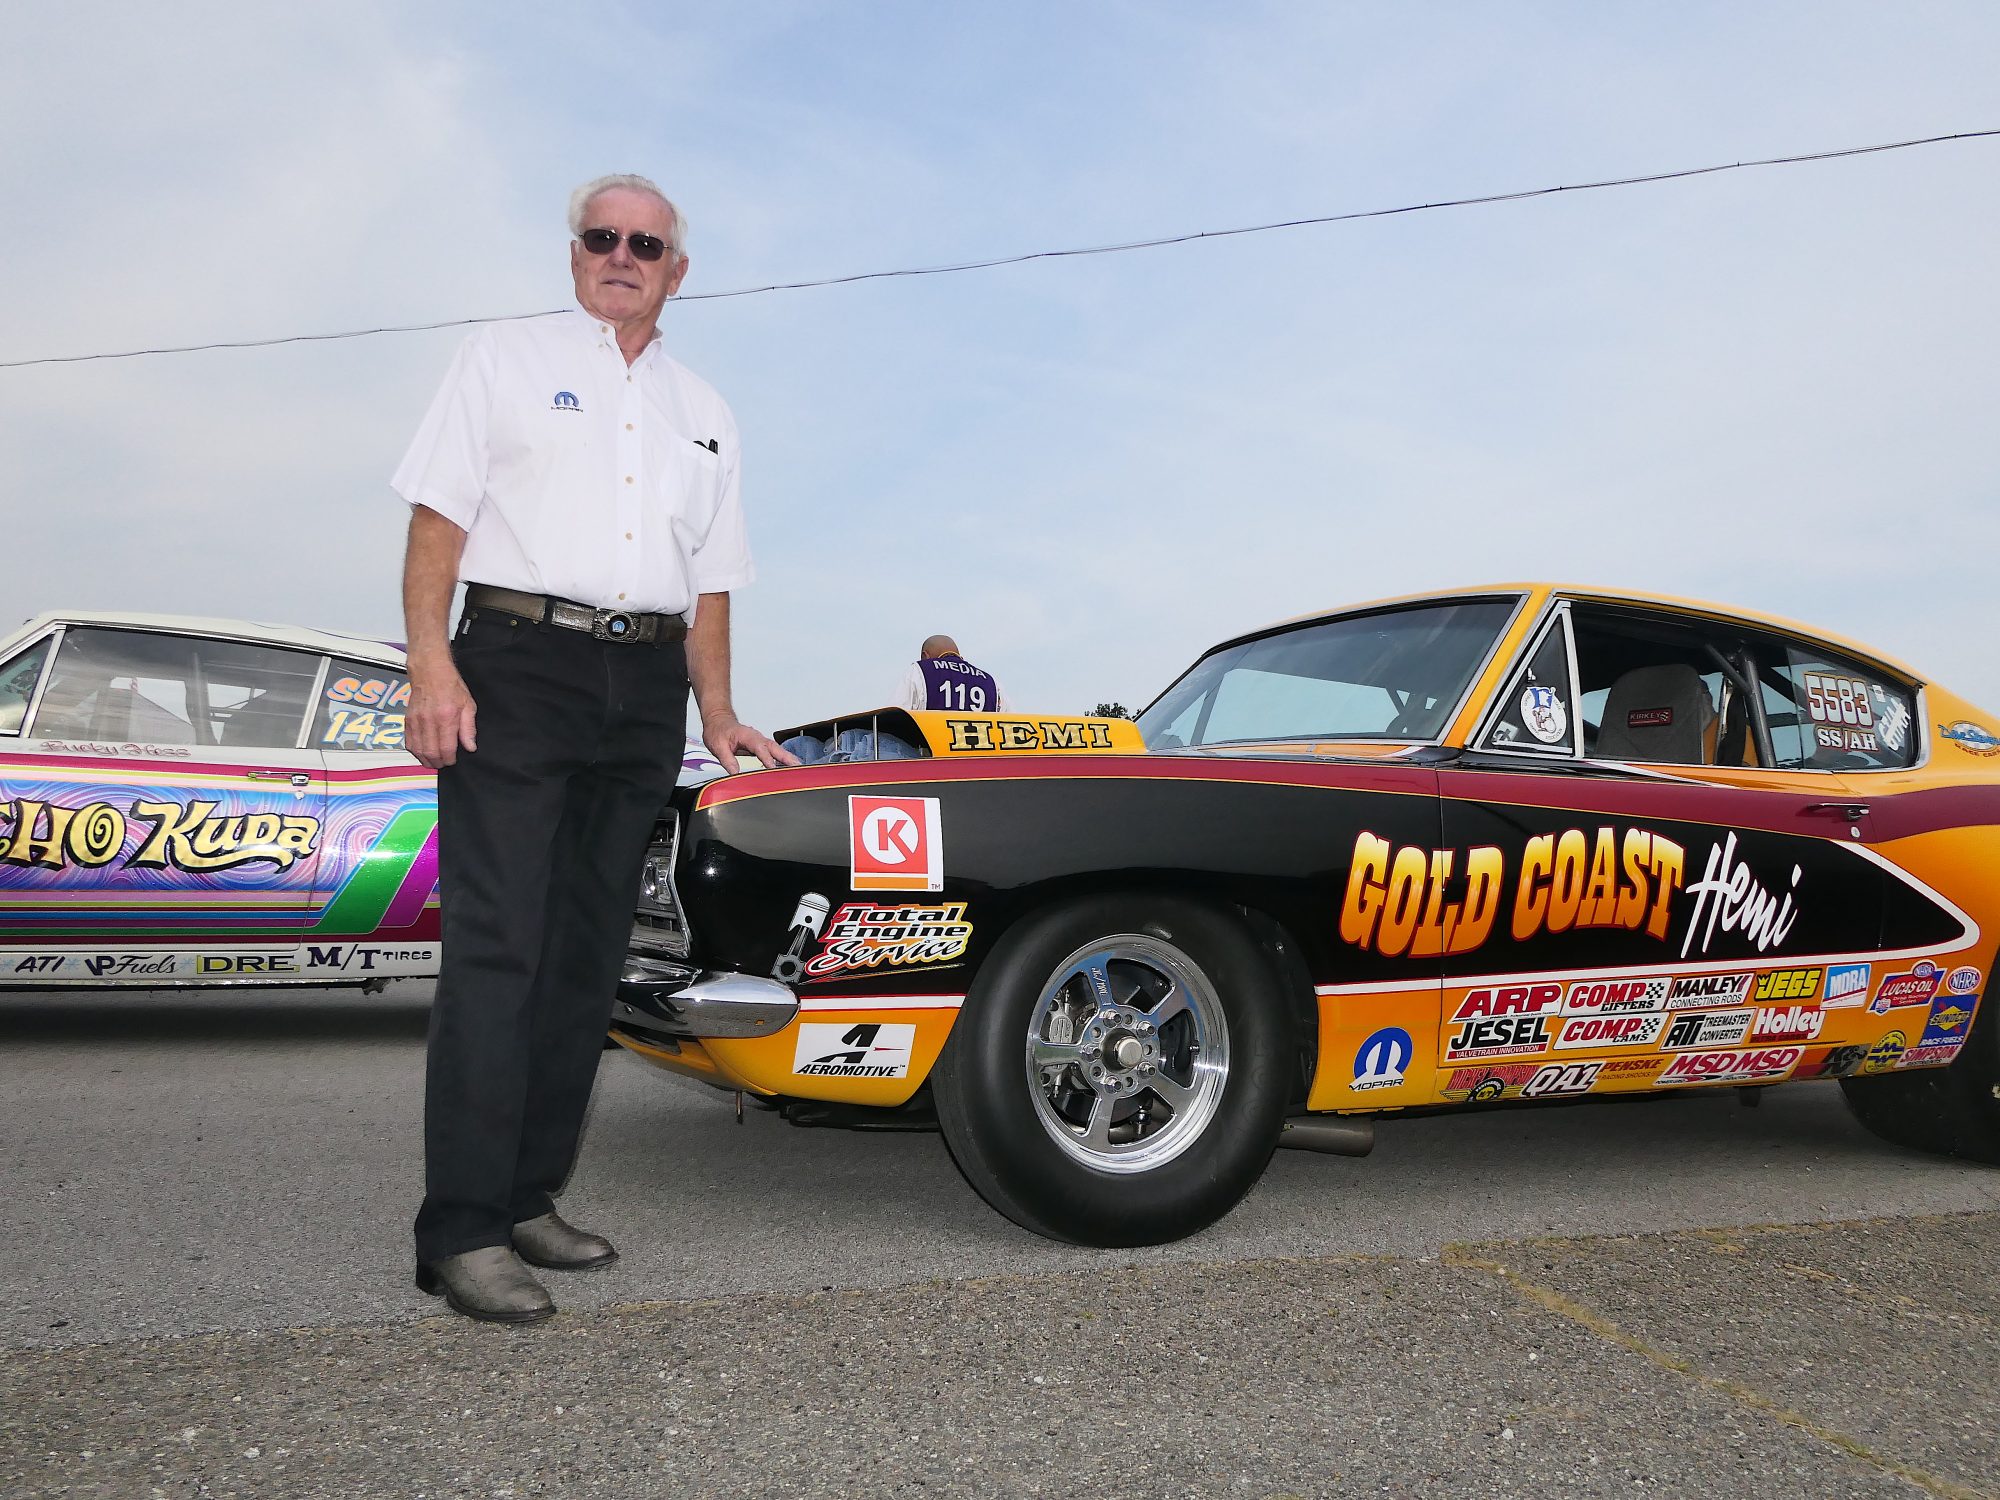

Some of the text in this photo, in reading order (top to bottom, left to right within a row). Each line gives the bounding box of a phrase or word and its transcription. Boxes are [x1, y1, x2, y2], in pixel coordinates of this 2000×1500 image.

[933, 661, 986, 679] MEDIA
[940, 680, 985, 712] 119
[1804, 673, 1874, 726] 5583
[1630, 712, 1660, 720] KIRKEY
[322, 711, 405, 745] 142
[946, 720, 1112, 750] HEMI
[1817, 728, 1879, 750] SS/AH
[1339, 826, 1801, 958] GOLD COAST Hemi
[843, 907, 962, 922] Total
[830, 924, 968, 941] Engine
[15, 956, 66, 973] ATI
[107, 955, 176, 975] Fuels
[202, 955, 295, 972] DRE
[306, 944, 433, 970] M/T TIRES
[810, 939, 963, 970] Service
[1670, 975, 1741, 998] MANLEY
[1756, 969, 1821, 999] JEGS
[1829, 967, 1867, 997] MDRA
[1881, 979, 1934, 997] LUCAS OIL
[1951, 972, 1976, 990] NHRA
[1454, 984, 1562, 1019] ARP
[1569, 982, 1647, 1008] COMP
[1670, 993, 1742, 1008] CONNECTING RODS
[1600, 1000, 1655, 1012] LIFTERS
[1563, 1017, 1643, 1042] COMP
[1663, 1014, 1707, 1048] ATI
[1702, 1013, 1751, 1028] TREEMASTER
[1752, 1006, 1827, 1040] Holley
[1450, 1017, 1550, 1050] JESEL
[1612, 1033, 1649, 1043] CAMS
[1699, 1028, 1744, 1042] CONVERTER
[1456, 1044, 1540, 1059] VALVETRAIN INNOVATION
[1664, 1047, 1800, 1076] MSD MSD
[1905, 1045, 1960, 1061] SIMPSON
[796, 1064, 898, 1076] AEROMOTIVE
[1600, 1058, 1664, 1073] PENSKE
[1349, 1079, 1404, 1091] MOPAR
[1522, 1063, 1601, 1097] QA1
